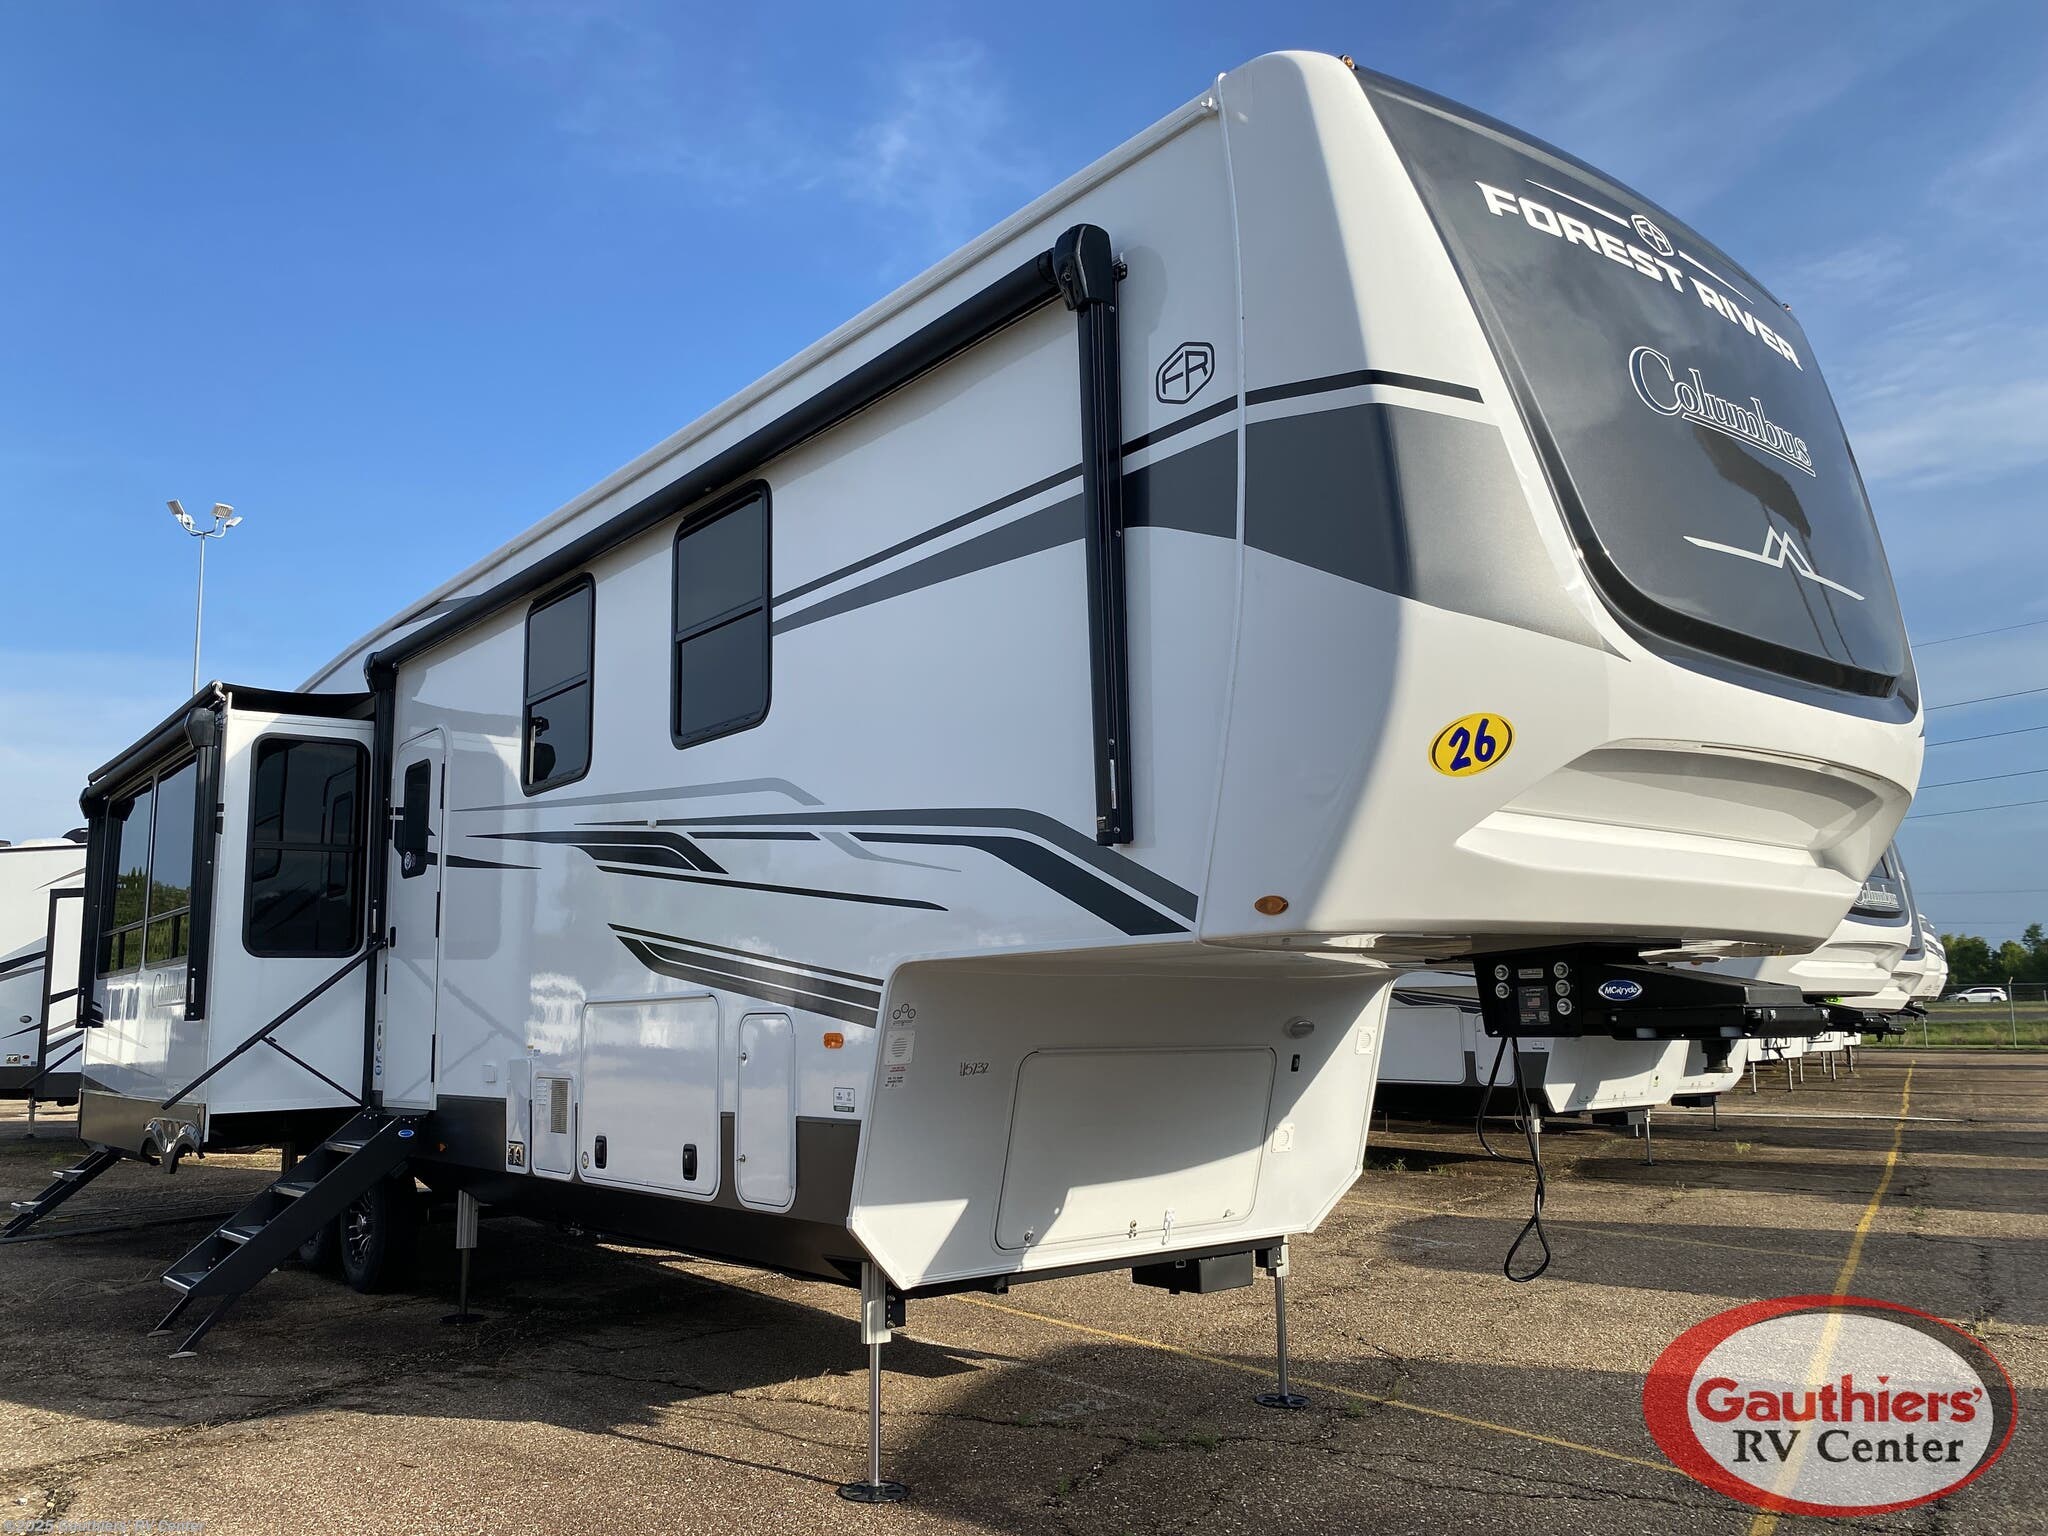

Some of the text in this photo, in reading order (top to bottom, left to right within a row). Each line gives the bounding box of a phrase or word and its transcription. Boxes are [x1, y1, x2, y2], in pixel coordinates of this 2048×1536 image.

[1475, 180, 1803, 371] FOREST RIVER
[1629, 346, 1812, 466] Columbus
[1448, 718, 1497, 772] 26
